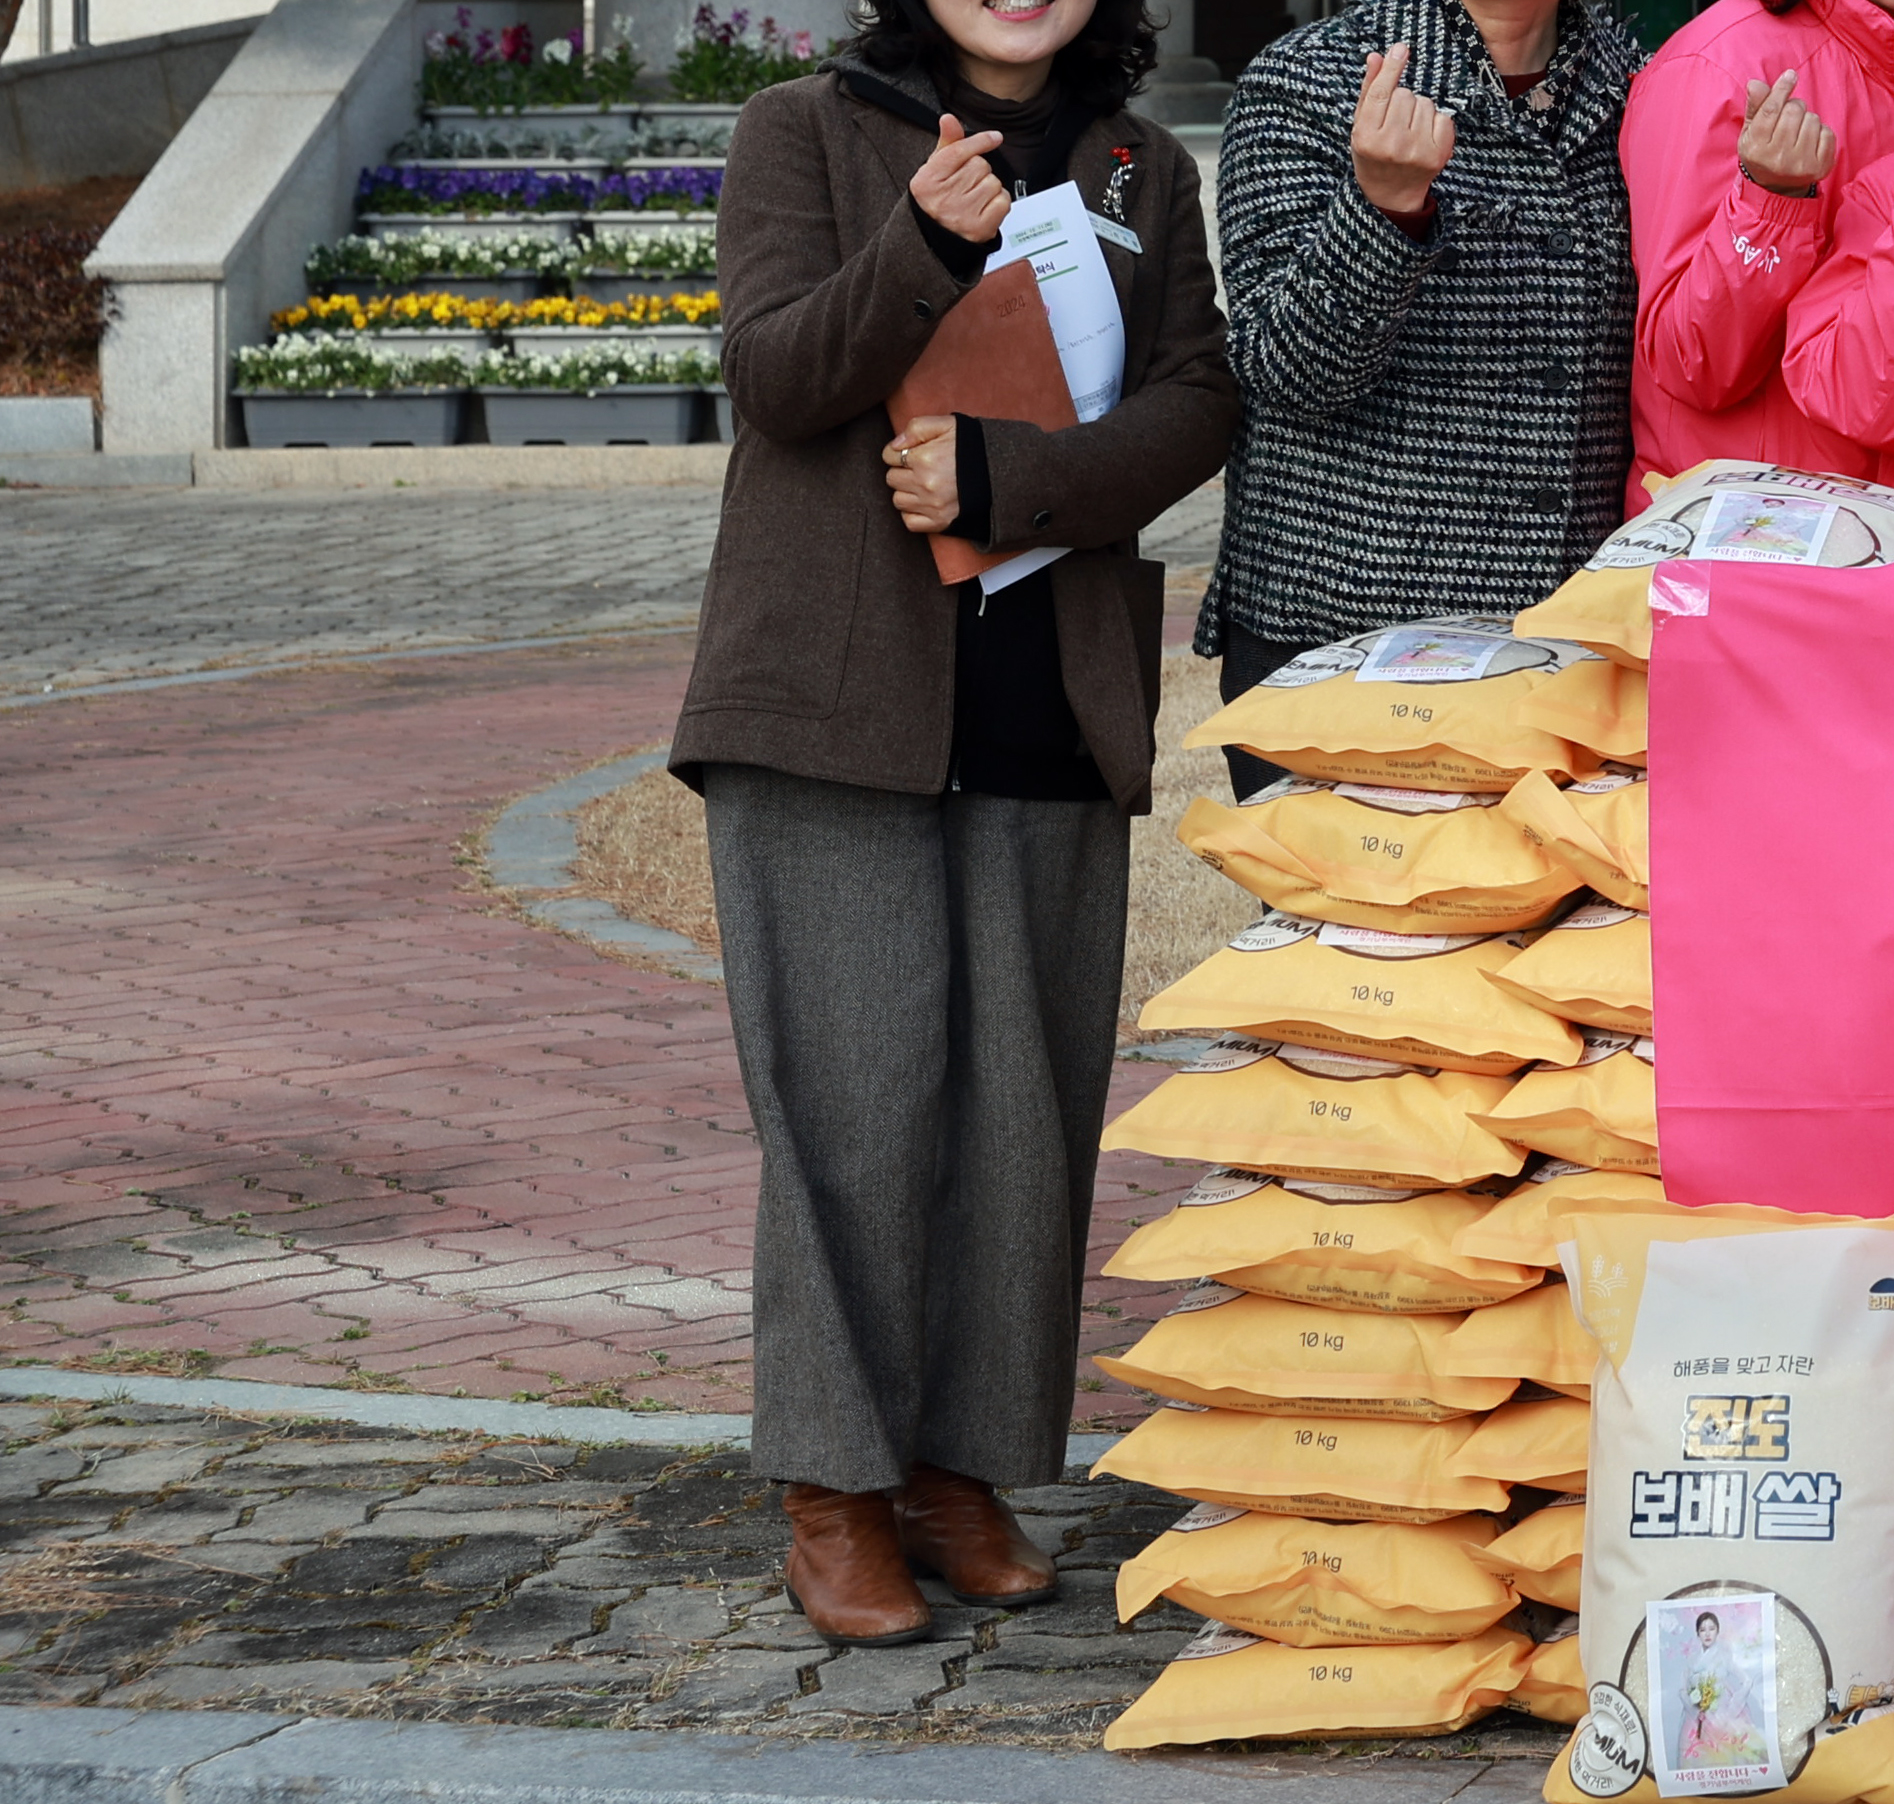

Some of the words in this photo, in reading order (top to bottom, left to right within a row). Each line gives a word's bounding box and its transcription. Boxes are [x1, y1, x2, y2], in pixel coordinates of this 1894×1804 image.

[997, 295, 1026, 318] 2024
[1609, 536, 1682, 555] EMIUM
[1390, 704, 1409, 718] 10
[1412, 705, 1433, 723] kg
[1360, 835, 1379, 852] 10
[1382, 839, 1404, 860] kg
[1351, 985, 1370, 1001] 10
[1373, 986, 1394, 1007] kg
[1308, 1100, 1328, 1116] 10
[1330, 1102, 1352, 1122] kg
[1312, 1231, 1330, 1246] 10
[1333, 1231, 1354, 1249] kg
[1299, 1331, 1319, 1348] 10
[1323, 1332, 1344, 1352] kg
[1674, 1358, 1729, 1377] 해풍을
[1738, 1356, 1770, 1374] 맞고
[1776, 1356, 1814, 1376] 자란
[1684, 1394, 1791, 1462] 진도
[1294, 1429, 1313, 1446] 10
[1316, 1431, 1338, 1451] kg
[1630, 1470, 1747, 1540] 보배
[1753, 1470, 1841, 1542] 쌀
[1322, 1552, 1342, 1573] kg
[1308, 1665, 1328, 1681] 10
[1332, 1665, 1353, 1683] kg
